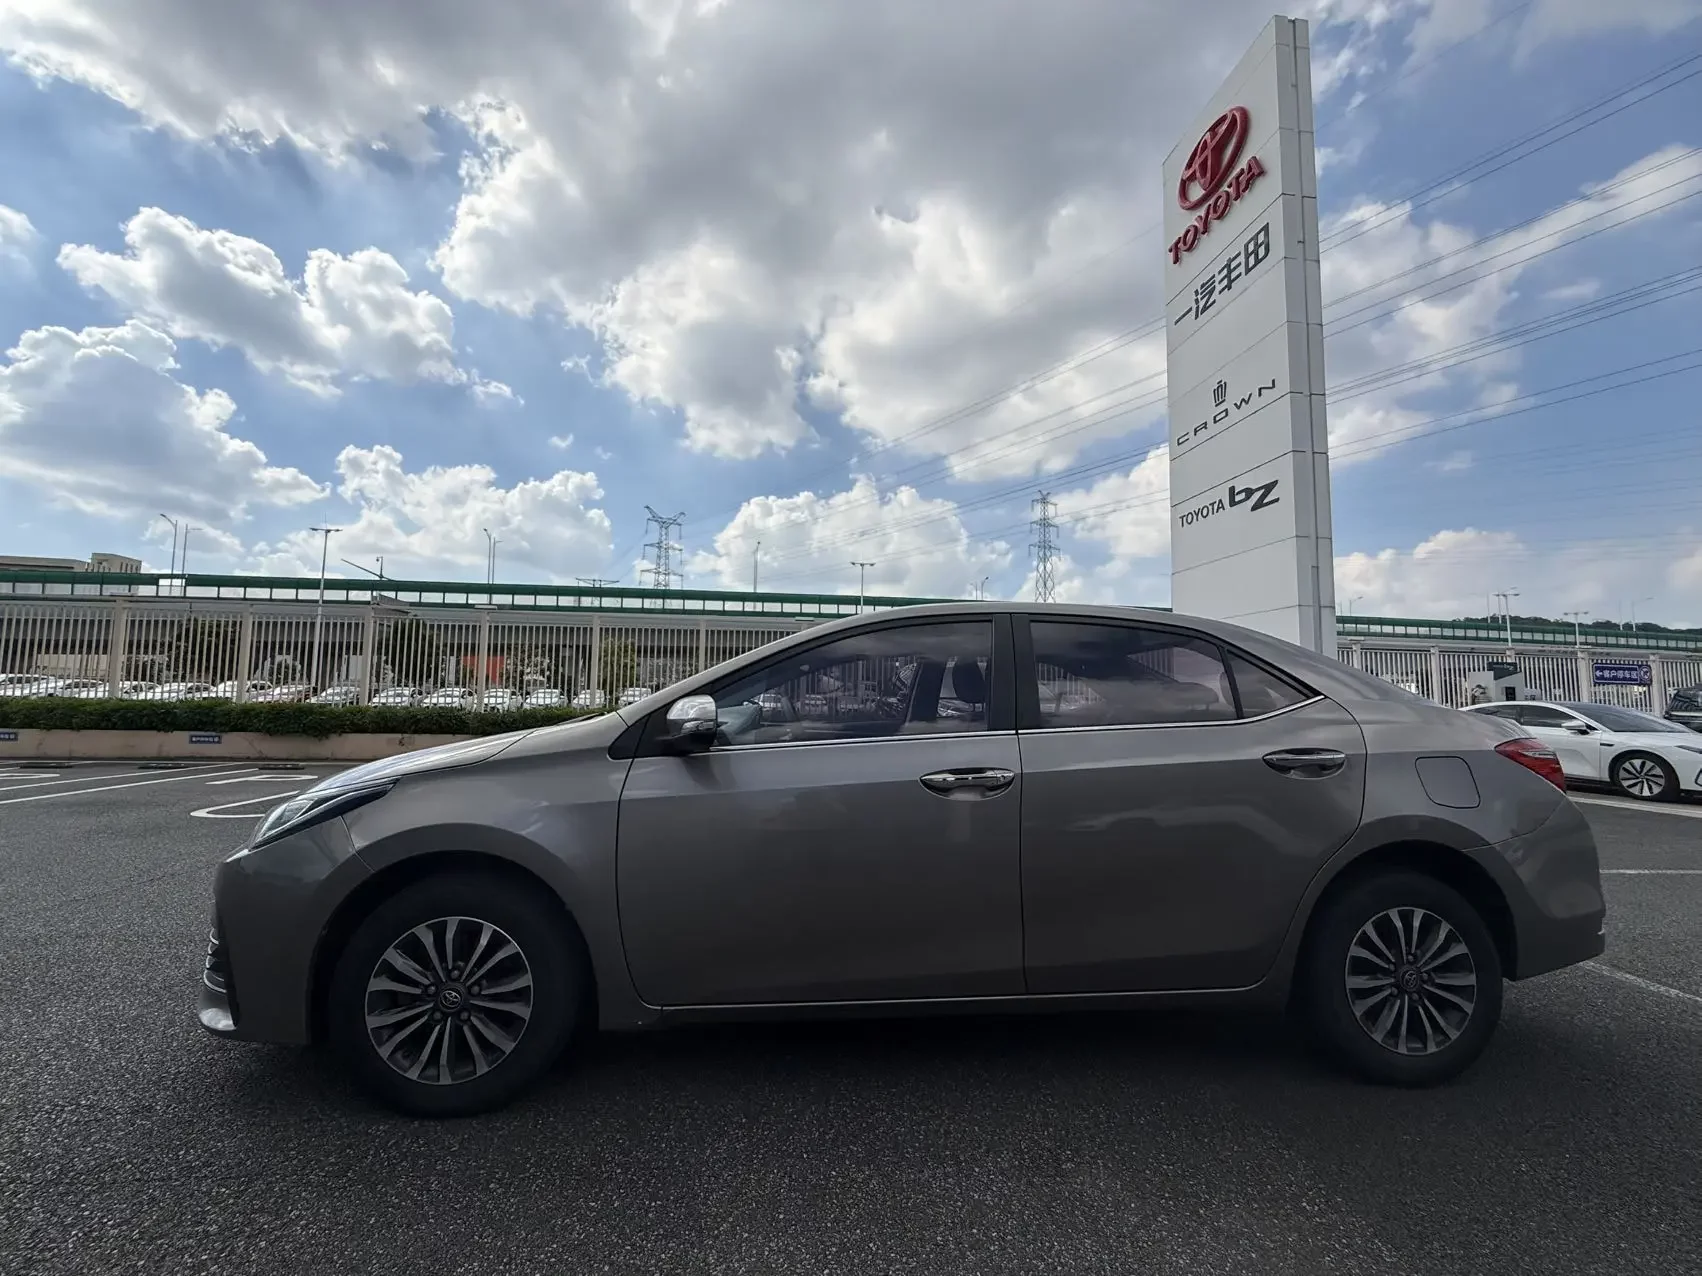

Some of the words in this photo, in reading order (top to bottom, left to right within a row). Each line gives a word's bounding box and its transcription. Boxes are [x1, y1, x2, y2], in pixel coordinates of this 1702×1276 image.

[1168, 156, 1266, 265] TOYOTA
[1174, 222, 1270, 326] 一汽丰田
[1177, 378, 1276, 446] CROWN
[1179, 498, 1225, 528] TOYOTA
